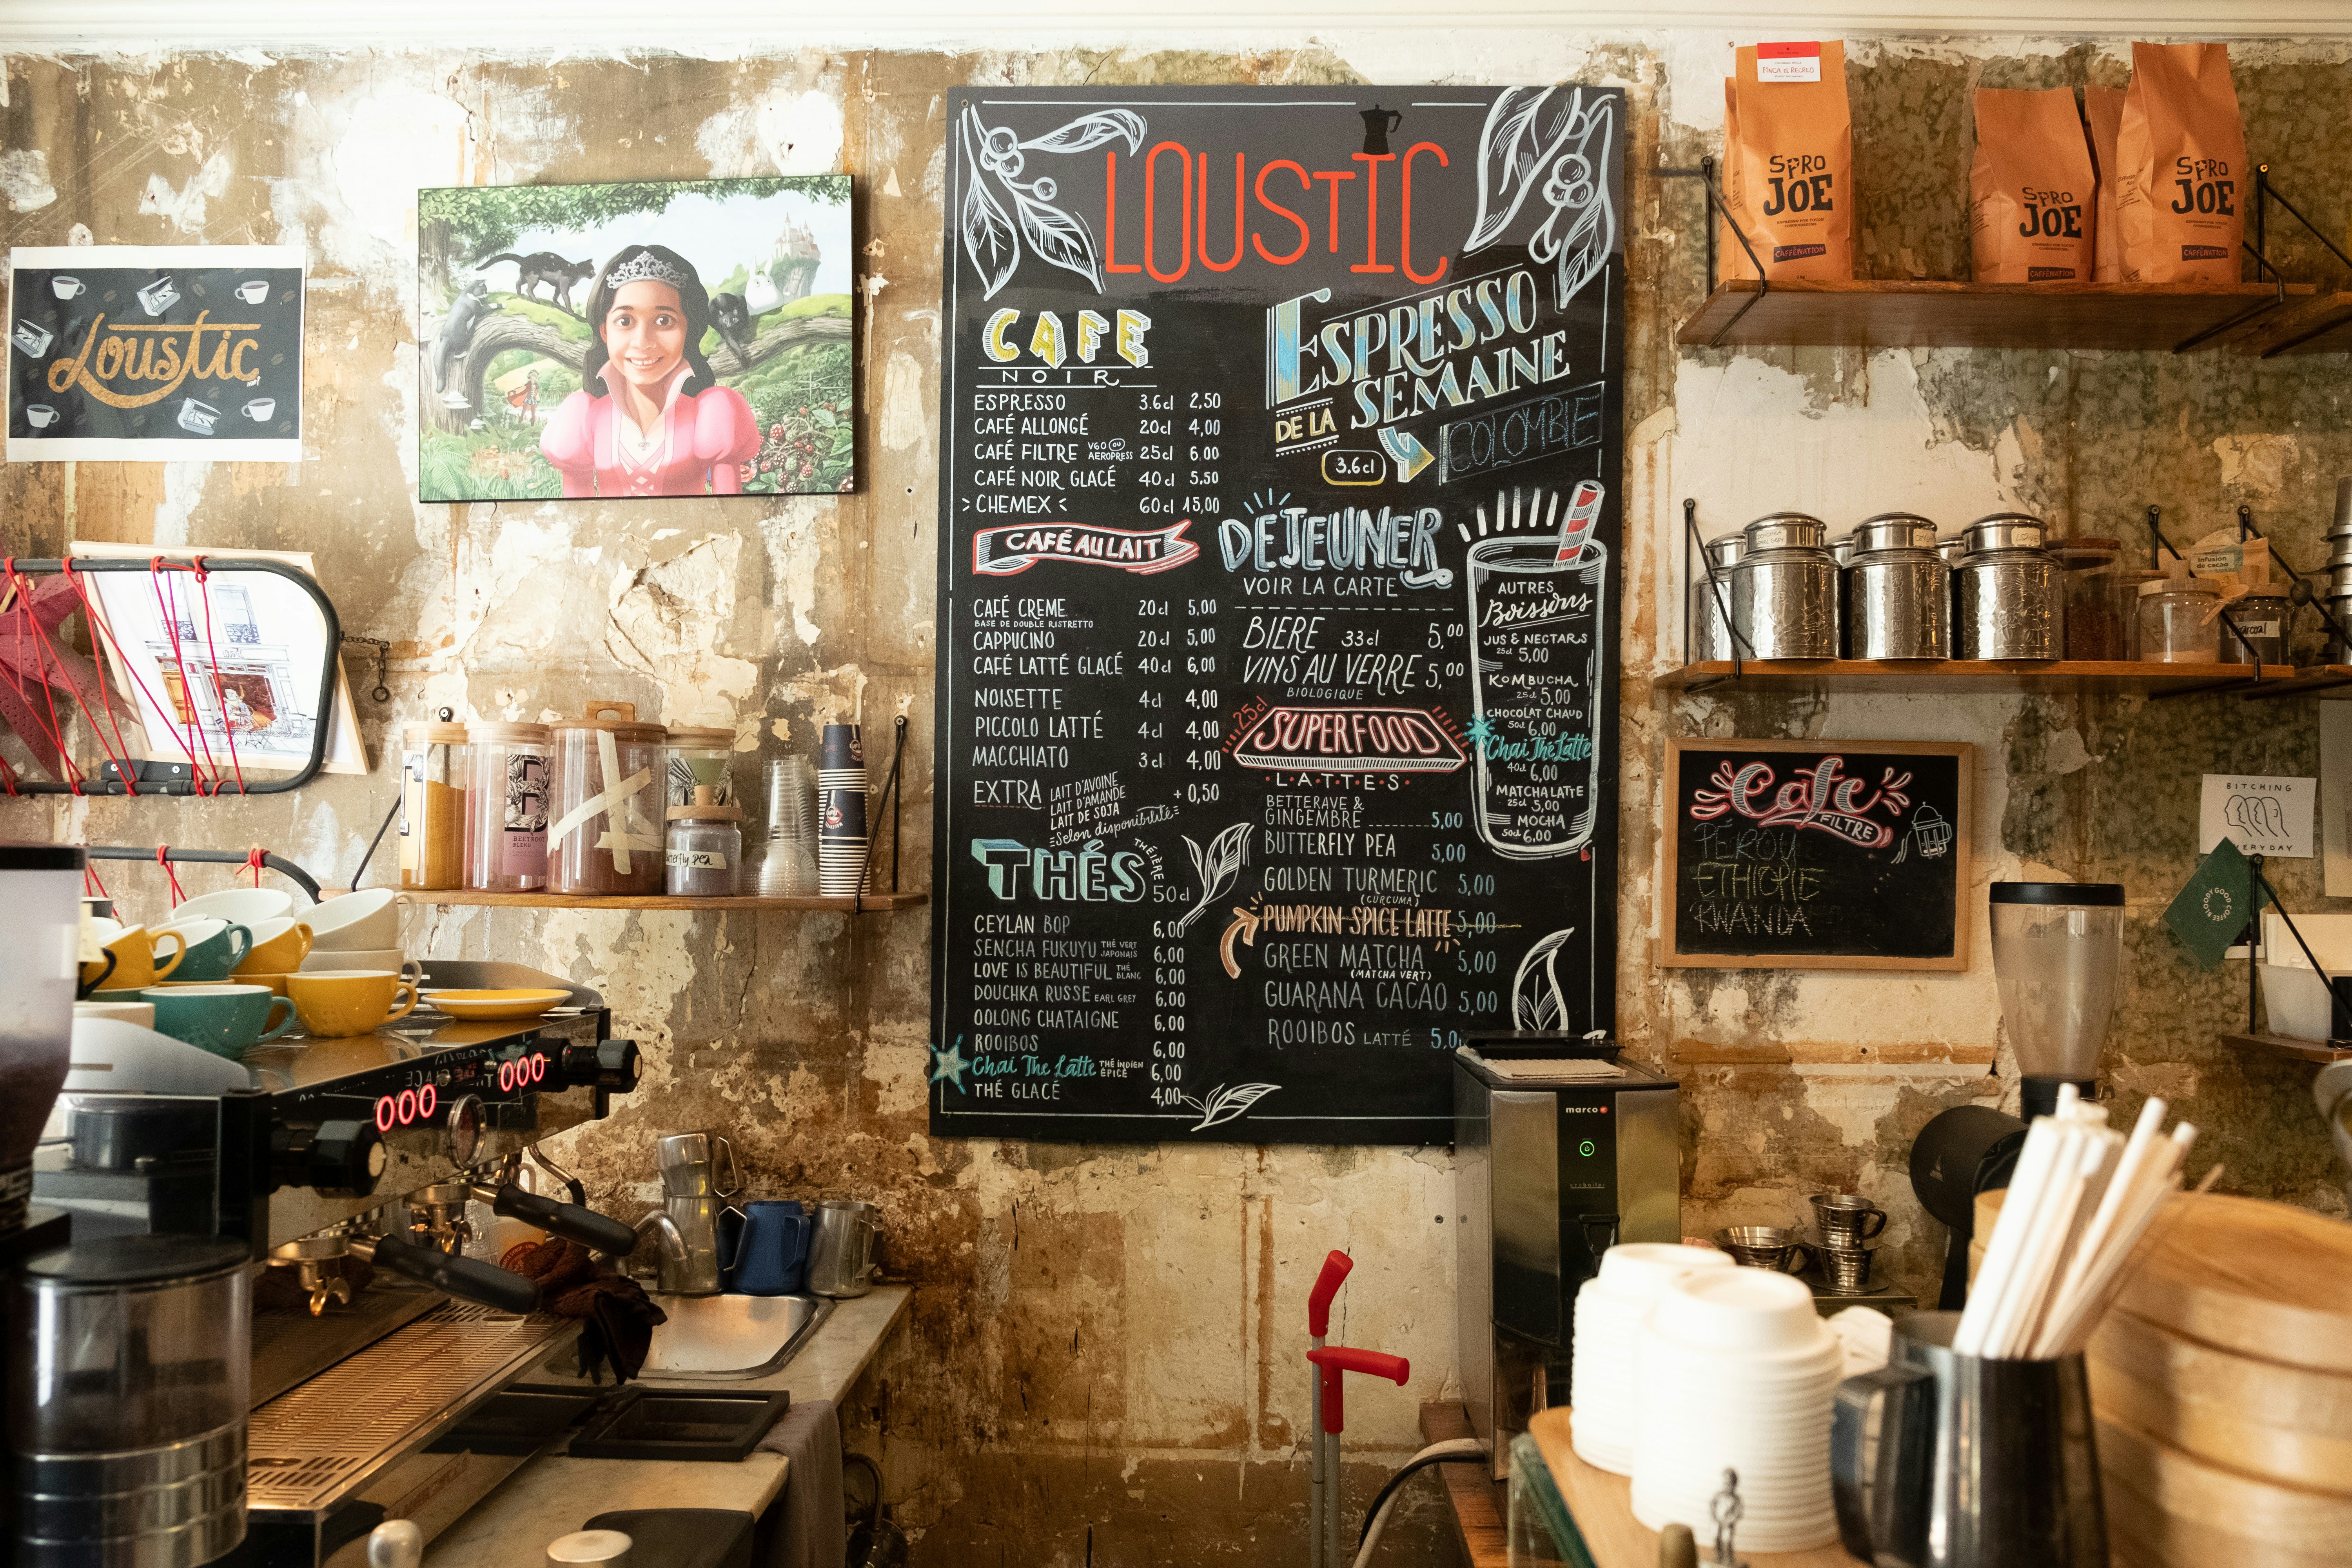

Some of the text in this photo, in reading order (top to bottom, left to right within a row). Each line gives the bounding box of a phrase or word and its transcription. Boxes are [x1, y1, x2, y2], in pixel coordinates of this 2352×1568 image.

[1769, 155, 1826, 180] SPRO
[2176, 157, 2229, 180] SPRO
[1764, 174, 1833, 216] JOE
[2022, 187, 2073, 207] SPRO
[2172, 179, 2234, 217] JOE
[1106, 141, 1449, 284] LOUSTIC
[2019, 203, 2082, 239] JOE
[982, 308, 1151, 369] CAFE
[1276, 270, 1536, 404] ESPRESSO
[1002, 370, 1119, 386] NOIR
[1351, 330, 1570, 429] SEMAINE
[975, 394, 1065, 411] ESPRESSO
[975, 413, 1089, 435] CAFÉ ALLONGÉ
[1276, 411, 1337, 443] DE LA
[1448, 393, 1601, 472] COLOMBIE
[975, 439, 1078, 463] CAFÉ FILTRE
[1088, 451, 1133, 461] AEROPRESS
[975, 465, 1116, 490] CAFÉ NOIR GLACÉ
[976, 495, 1051, 513] CHEMEX
[1005, 529, 1162, 560] CAFÉ AU LAIT
[1218, 506, 1454, 589] DEJEUNER
[1244, 576, 1398, 597] VOIR LA CARTE
[1498, 581, 1554, 595] AUTRES
[974, 595, 1067, 620] CAFÉ CREME
[1478, 592, 1593, 627] Boissons
[973, 631, 1054, 650] CAPPUCINO
[1243, 616, 1325, 653] BIERE
[1484, 633, 1588, 646] JUS NECTARS
[973, 652, 1123, 676] CAFÉ LATTÉ GLACÉ
[1244, 653, 1422, 696] VINS AU VERRE
[1489, 674, 1579, 688] KOMBUCHA
[975, 688, 1063, 710] NOISETTE
[1287, 687, 1363, 700] BIOLOGIQUE
[975, 710, 1103, 738] PICCOLO LATTÉ
[1487, 708, 1583, 720] CHOCOLAT CHAUD
[1254, 710, 1442, 753] SUPERFOOD
[972, 745, 1068, 768] MACCHIATO
[1486, 735, 1529, 761] Chai
[1554, 731, 1592, 761] Latte
[974, 779, 1042, 809] EXTRA
[1051, 771, 1119, 802] LAIT D'AVOINE
[1496, 785, 1584, 797] MATCHA LATTE
[2227, 783, 2292, 792] BITCHING
[1051, 785, 1126, 816] LAIT D'AMANDE
[1267, 795, 1347, 809] BETTERAVE
[1051, 802, 1120, 830] LAIT DE SOJA
[1056, 804, 1174, 846] Selon disponibilité
[1265, 809, 1362, 828] GINGEMBRE
[1518, 814, 1566, 828] MOCHA
[1819, 813, 1874, 840] FILTRE
[1265, 829, 1396, 857] BUTTERFLY PEA
[971, 838, 1146, 902] THÉS
[1134, 838, 1164, 880] THÉIÈRE
[1264, 867, 1437, 897] GOLDEN TURMERIC
[1693, 860, 1827, 902] ETHIOPIE
[2203, 887, 2232, 921] BLOODY GOOD COFFEE
[975, 915, 1070, 934] CEYLAN BOP
[1263, 905, 1451, 938] PUMPKIN SPICE LATTE
[1690, 901, 1813, 937] RWANDA
[974, 939, 1097, 958] SENCHA FUKUYU
[1101, 939, 1116, 948] THÉ
[1101, 949, 1138, 958] JAPONAIS
[1265, 943, 1424, 973] GREEN MATCHA
[974, 962, 1112, 980] LOVE IS BEAUTIFUL
[1117, 971, 1141, 980] BLANC
[975, 985, 1136, 1003] DOUCHKA RUSSE EARL GREY
[1265, 981, 1446, 1013] GUARANA CACAO
[974, 1009, 1119, 1029] OOLONG CHATAIGNE
[975, 1034, 1038, 1053] ROOIBOS
[1269, 1018, 1411, 1050] ROOIBOS LATTÉ
[972, 1056, 1017, 1077] Chai
[1054, 1054, 1097, 1078] Latte
[1099, 1058, 1114, 1068] THÉ
[1100, 1067, 1127, 1078] ÉPICÉ
[975, 1080, 1060, 1100] THÉ GLACÉ
[510, 1246, 522, 1256] SYRUP
